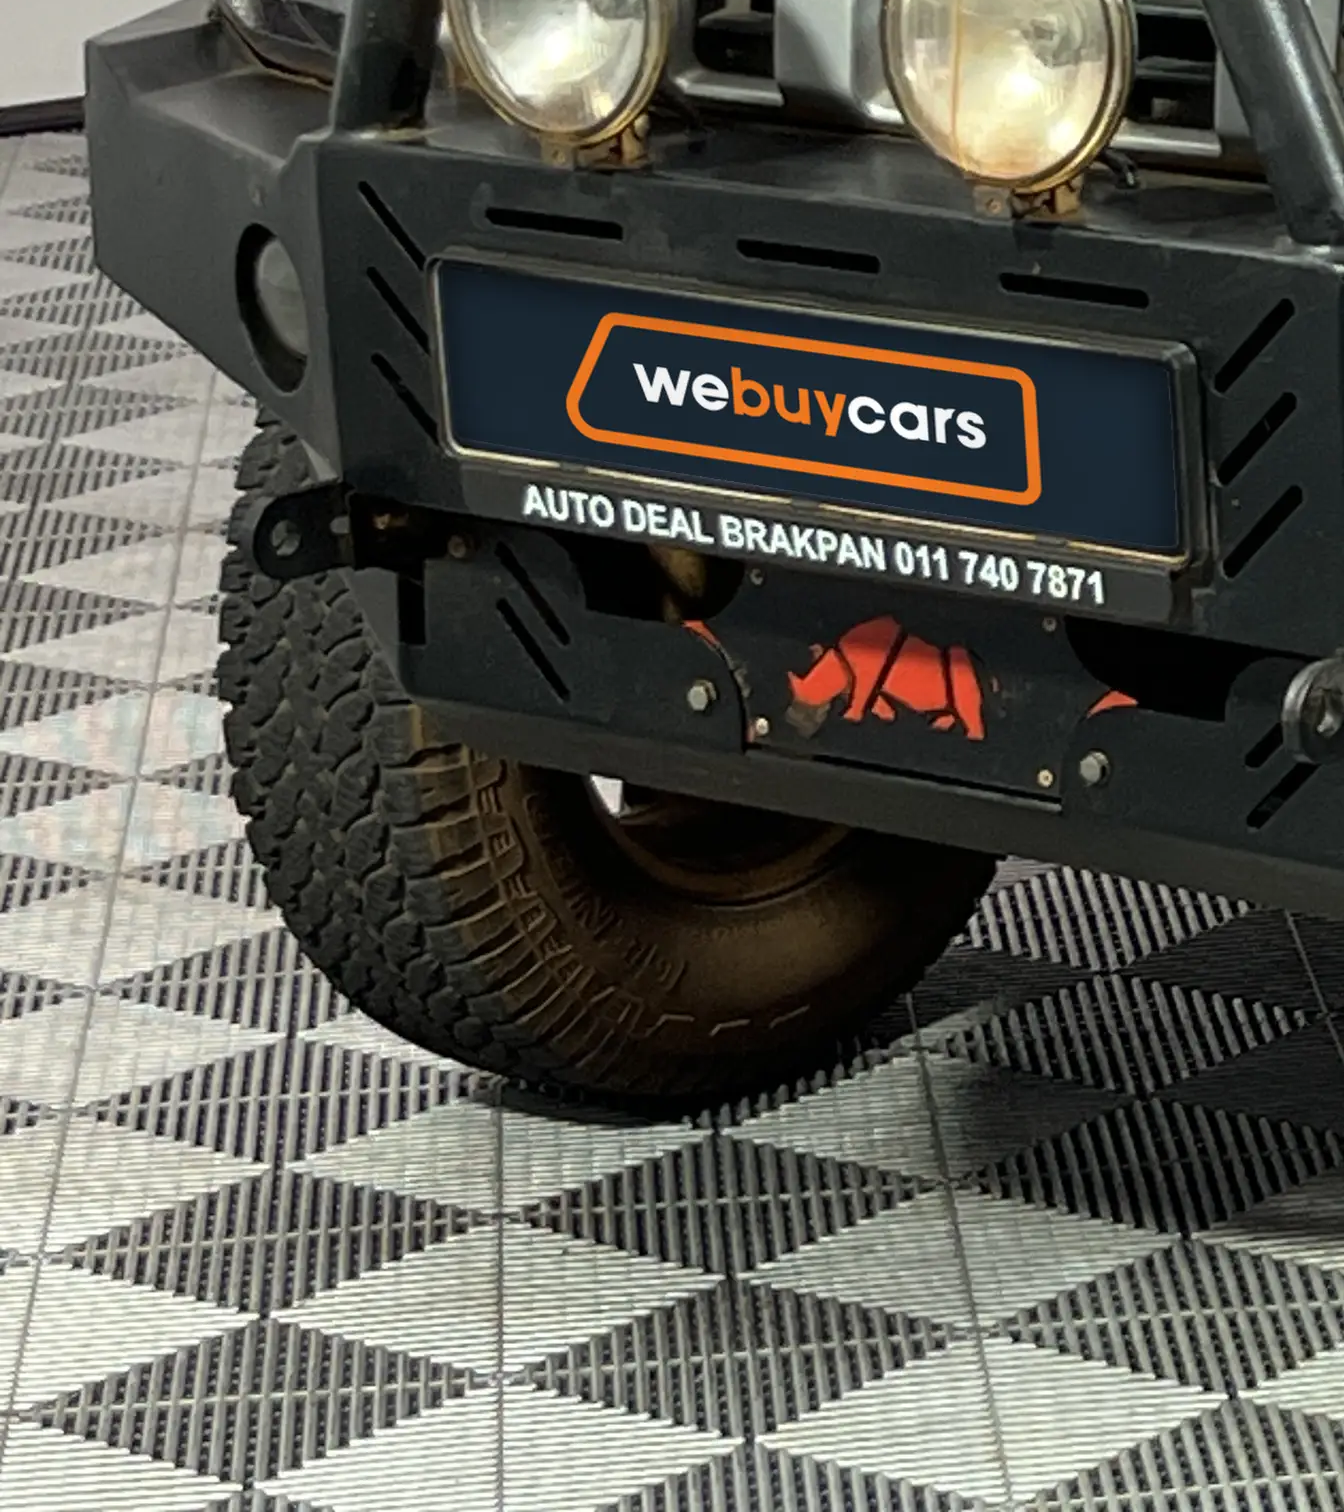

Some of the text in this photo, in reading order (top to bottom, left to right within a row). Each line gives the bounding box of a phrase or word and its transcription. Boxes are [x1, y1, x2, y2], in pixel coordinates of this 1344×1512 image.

[522, 484, 1105, 605] AUTO DEAL BRAKPAN 011 740 7871
